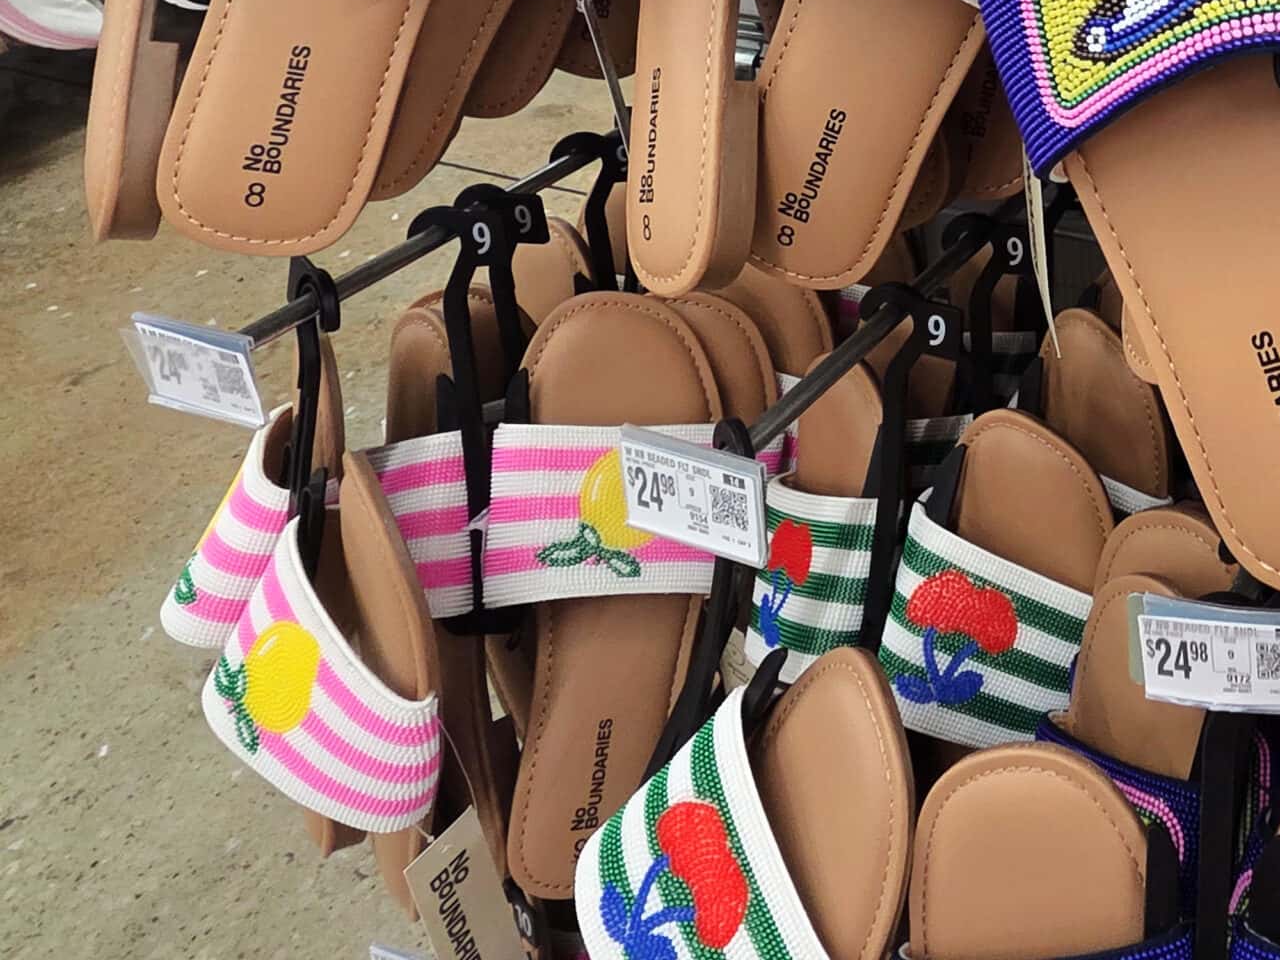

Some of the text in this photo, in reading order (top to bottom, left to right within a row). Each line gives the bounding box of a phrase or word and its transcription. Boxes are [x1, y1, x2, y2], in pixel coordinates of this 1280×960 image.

[262, 45, 312, 174] BOUNDARIES
[645, 67, 662, 204] BOUNDARIES
[242, 143, 266, 172] NO
[793, 108, 847, 224] BOUNDARIES
[244, 182, 266, 208] 8
[777, 191, 798, 218] NO
[514, 204, 532, 234] 9
[642, 214, 652, 241] 8
[472, 222, 492, 255] 9
[776, 224, 796, 247] 8
[1006, 237, 1024, 266] 9
[927, 315, 946, 347] 9
[585, 718, 614, 830] BOUNDARIES
[571, 807, 586, 831] NO
[448, 848, 471, 884] NO
